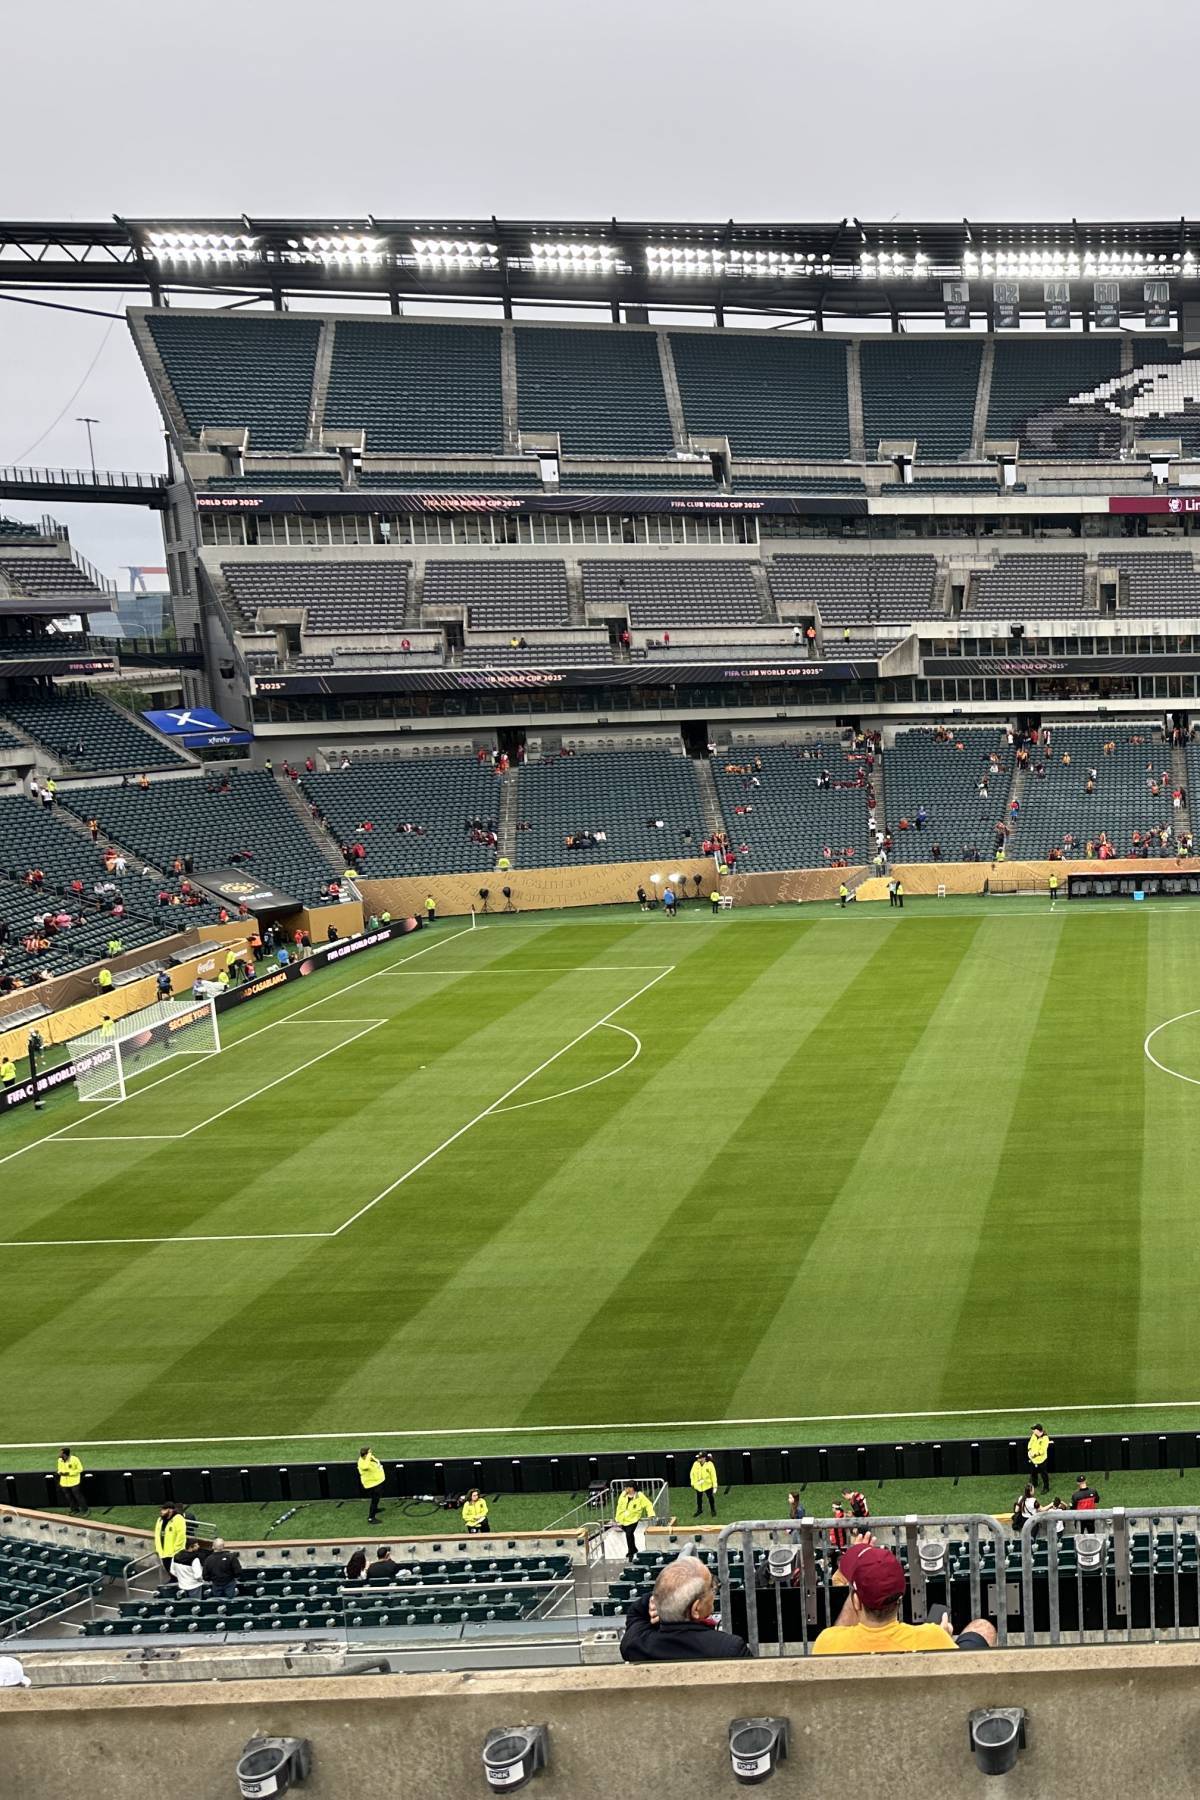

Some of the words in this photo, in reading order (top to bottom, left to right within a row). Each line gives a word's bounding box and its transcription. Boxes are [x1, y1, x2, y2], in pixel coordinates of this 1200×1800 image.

[951, 284, 962, 303] 5
[995, 284, 1017, 303] 92
[1046, 283, 1067, 303] 44
[1145, 283, 1167, 303] 70
[208, 736, 231, 745] xfinity
[327, 952, 338, 961] FIFA
[338, 946, 351, 957] CLUB
[350, 939, 368, 953] WORLD
[367, 935, 377, 945] CUP
[252, 972, 287, 994] CASABLANCA
[168, 1015, 193, 1032] SECURE
[7, 1091, 27, 1105] FIFA
[26, 1079, 48, 1096] CUB
[47, 1066, 77, 1086] WORLD
[77, 1060, 92, 1073] CUP
